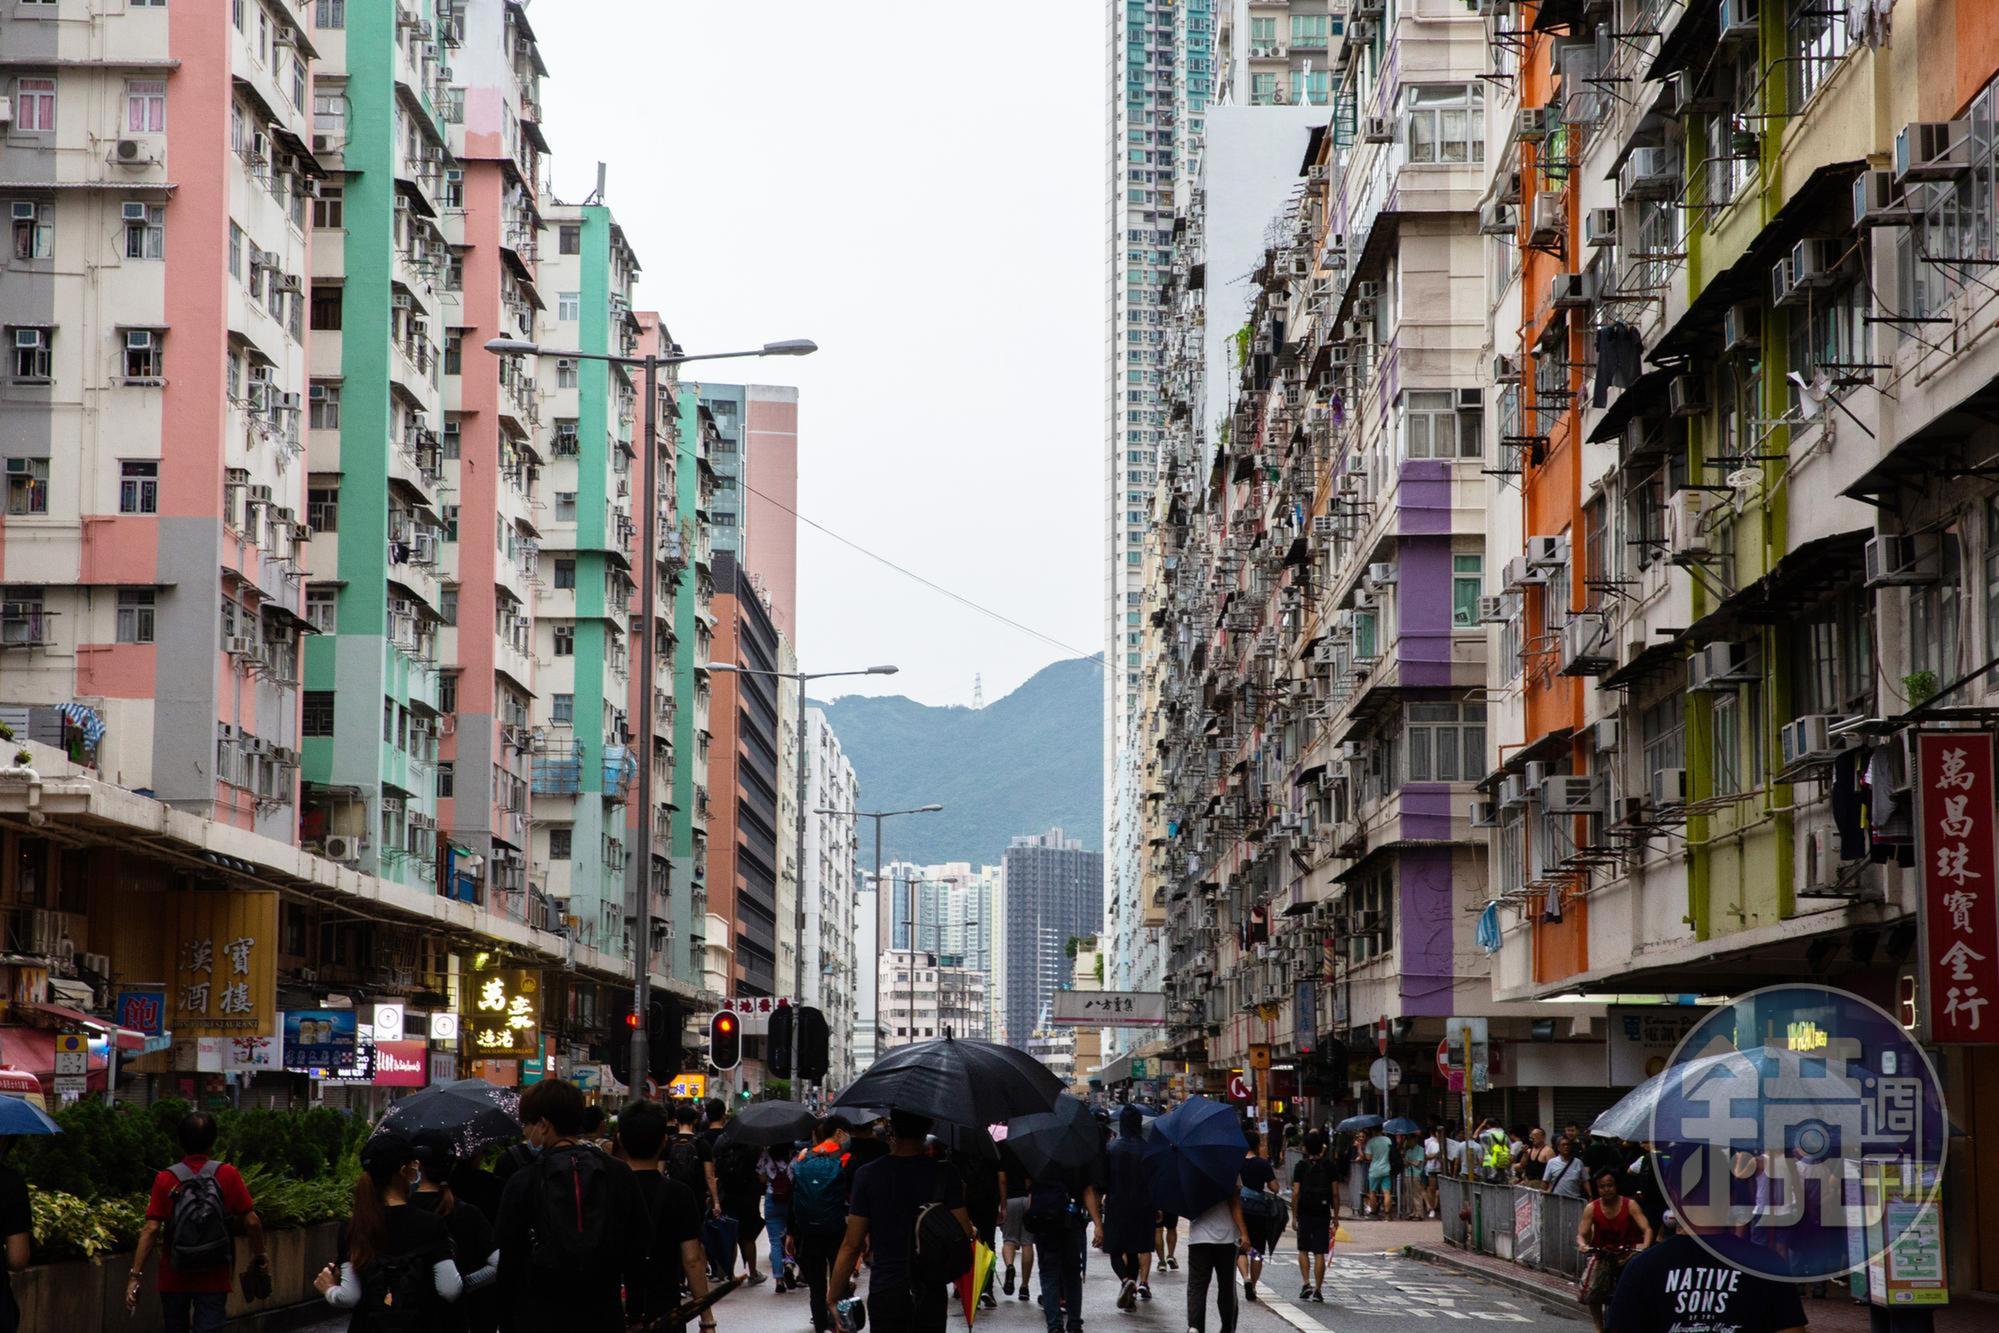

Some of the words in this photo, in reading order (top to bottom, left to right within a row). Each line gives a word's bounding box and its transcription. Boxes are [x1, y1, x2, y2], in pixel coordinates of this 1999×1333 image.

[1936, 748, 1989, 1031] 萬昌珠寶金行
[1085, 997, 1134, 1012] 八方雲集
[1665, 1267, 1742, 1293] NATIVE
[1343, 1305, 1536, 1323] BUS
[1674, 1290, 1729, 1314] SONS
